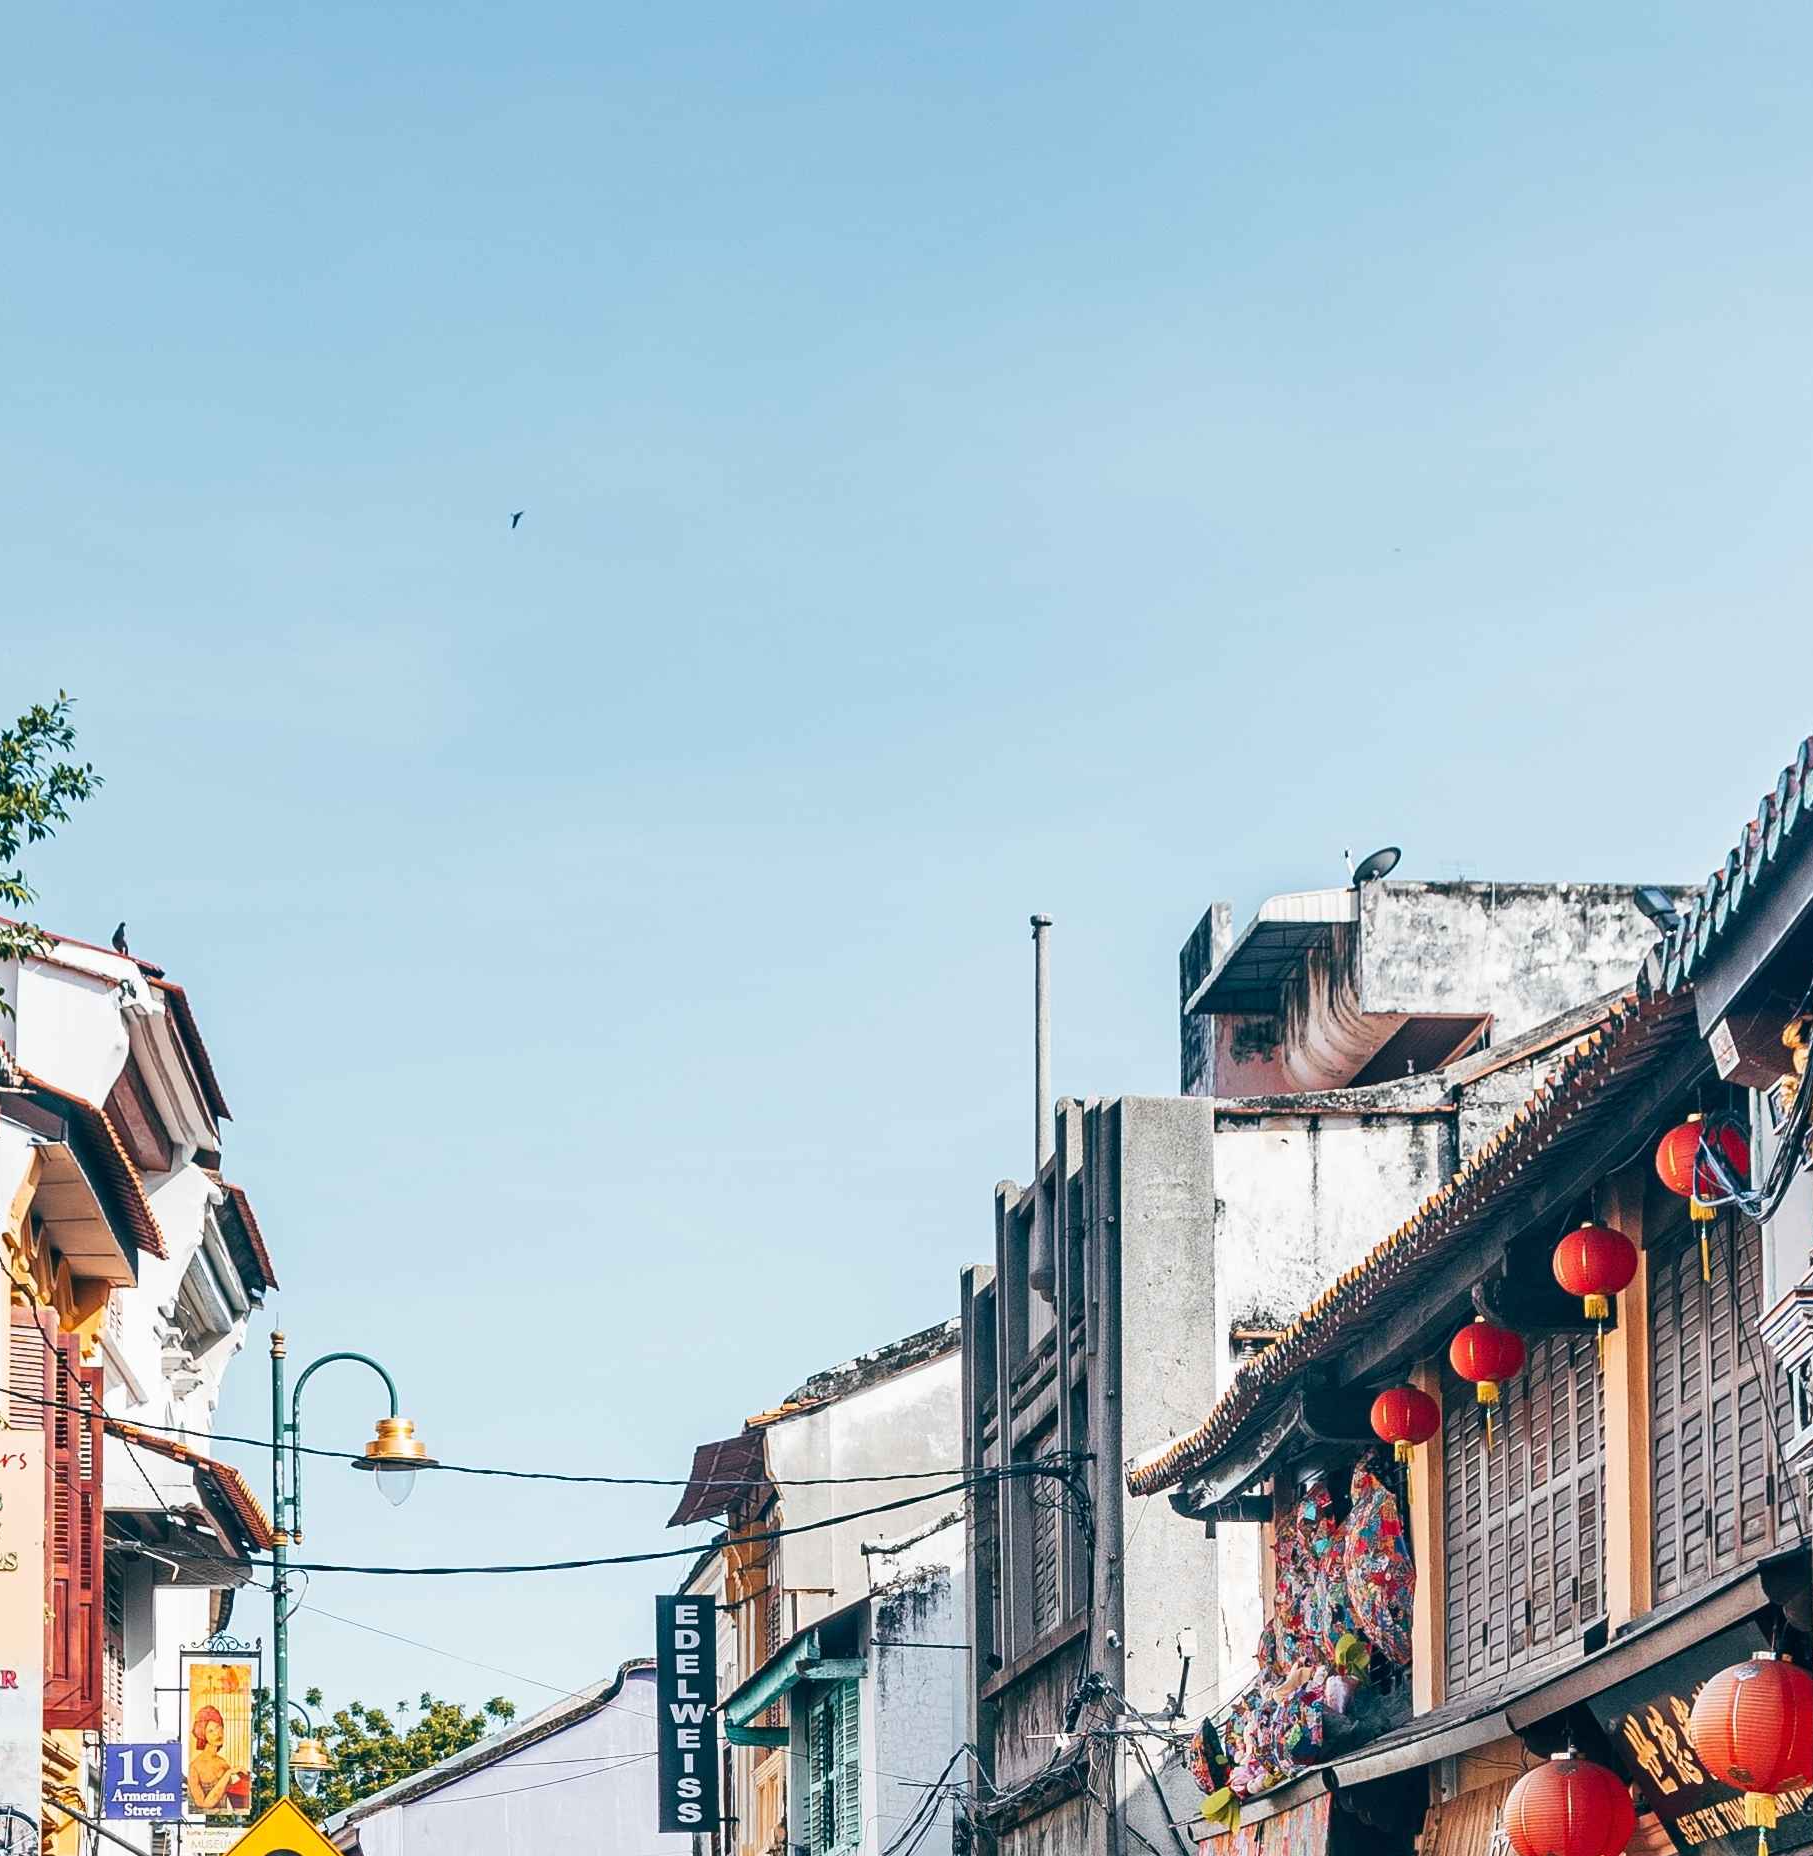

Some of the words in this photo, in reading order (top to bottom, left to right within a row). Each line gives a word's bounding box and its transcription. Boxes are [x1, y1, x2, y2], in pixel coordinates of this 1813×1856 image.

[669, 1604, 707, 1824] EDELWEISS
[117, 1749, 170, 1788] 19
[112, 1789, 175, 1802] Armenian
[124, 1803, 162, 1817] Street
[1716, 1796, 1747, 1832] TON
